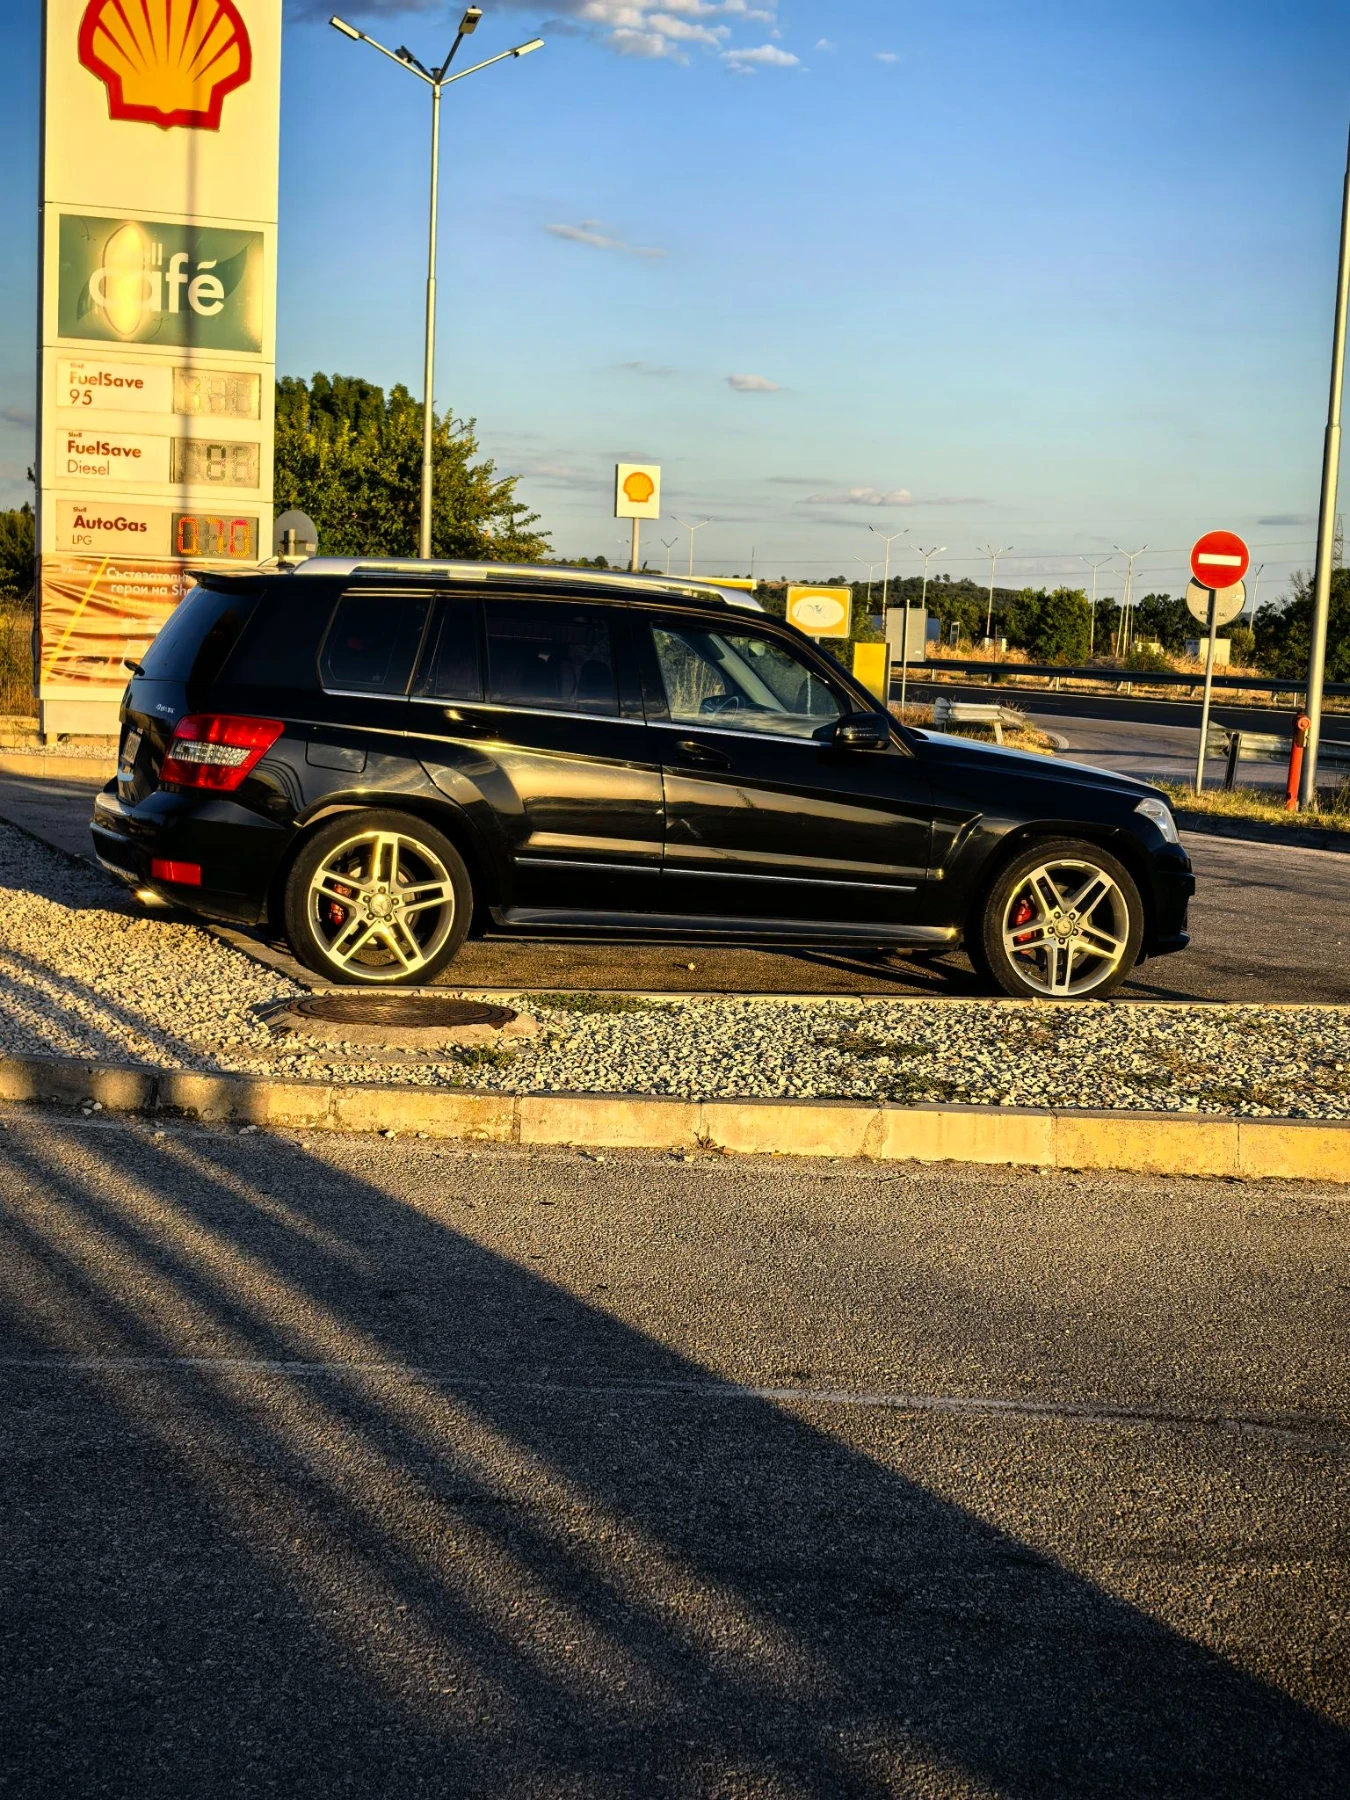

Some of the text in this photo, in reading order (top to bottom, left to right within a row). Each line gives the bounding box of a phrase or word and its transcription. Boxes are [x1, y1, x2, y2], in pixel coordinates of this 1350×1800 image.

[69, 371, 144, 389] FuelSave
[69, 389, 93, 405] 95
[67, 440, 142, 458] FuelSave
[67, 459, 110, 475] Diesel
[73, 514, 148, 532] AutoGas
[72, 534, 93, 545] LPG
[110, 584, 149, 597] герои
[151, 587, 168, 595] на
